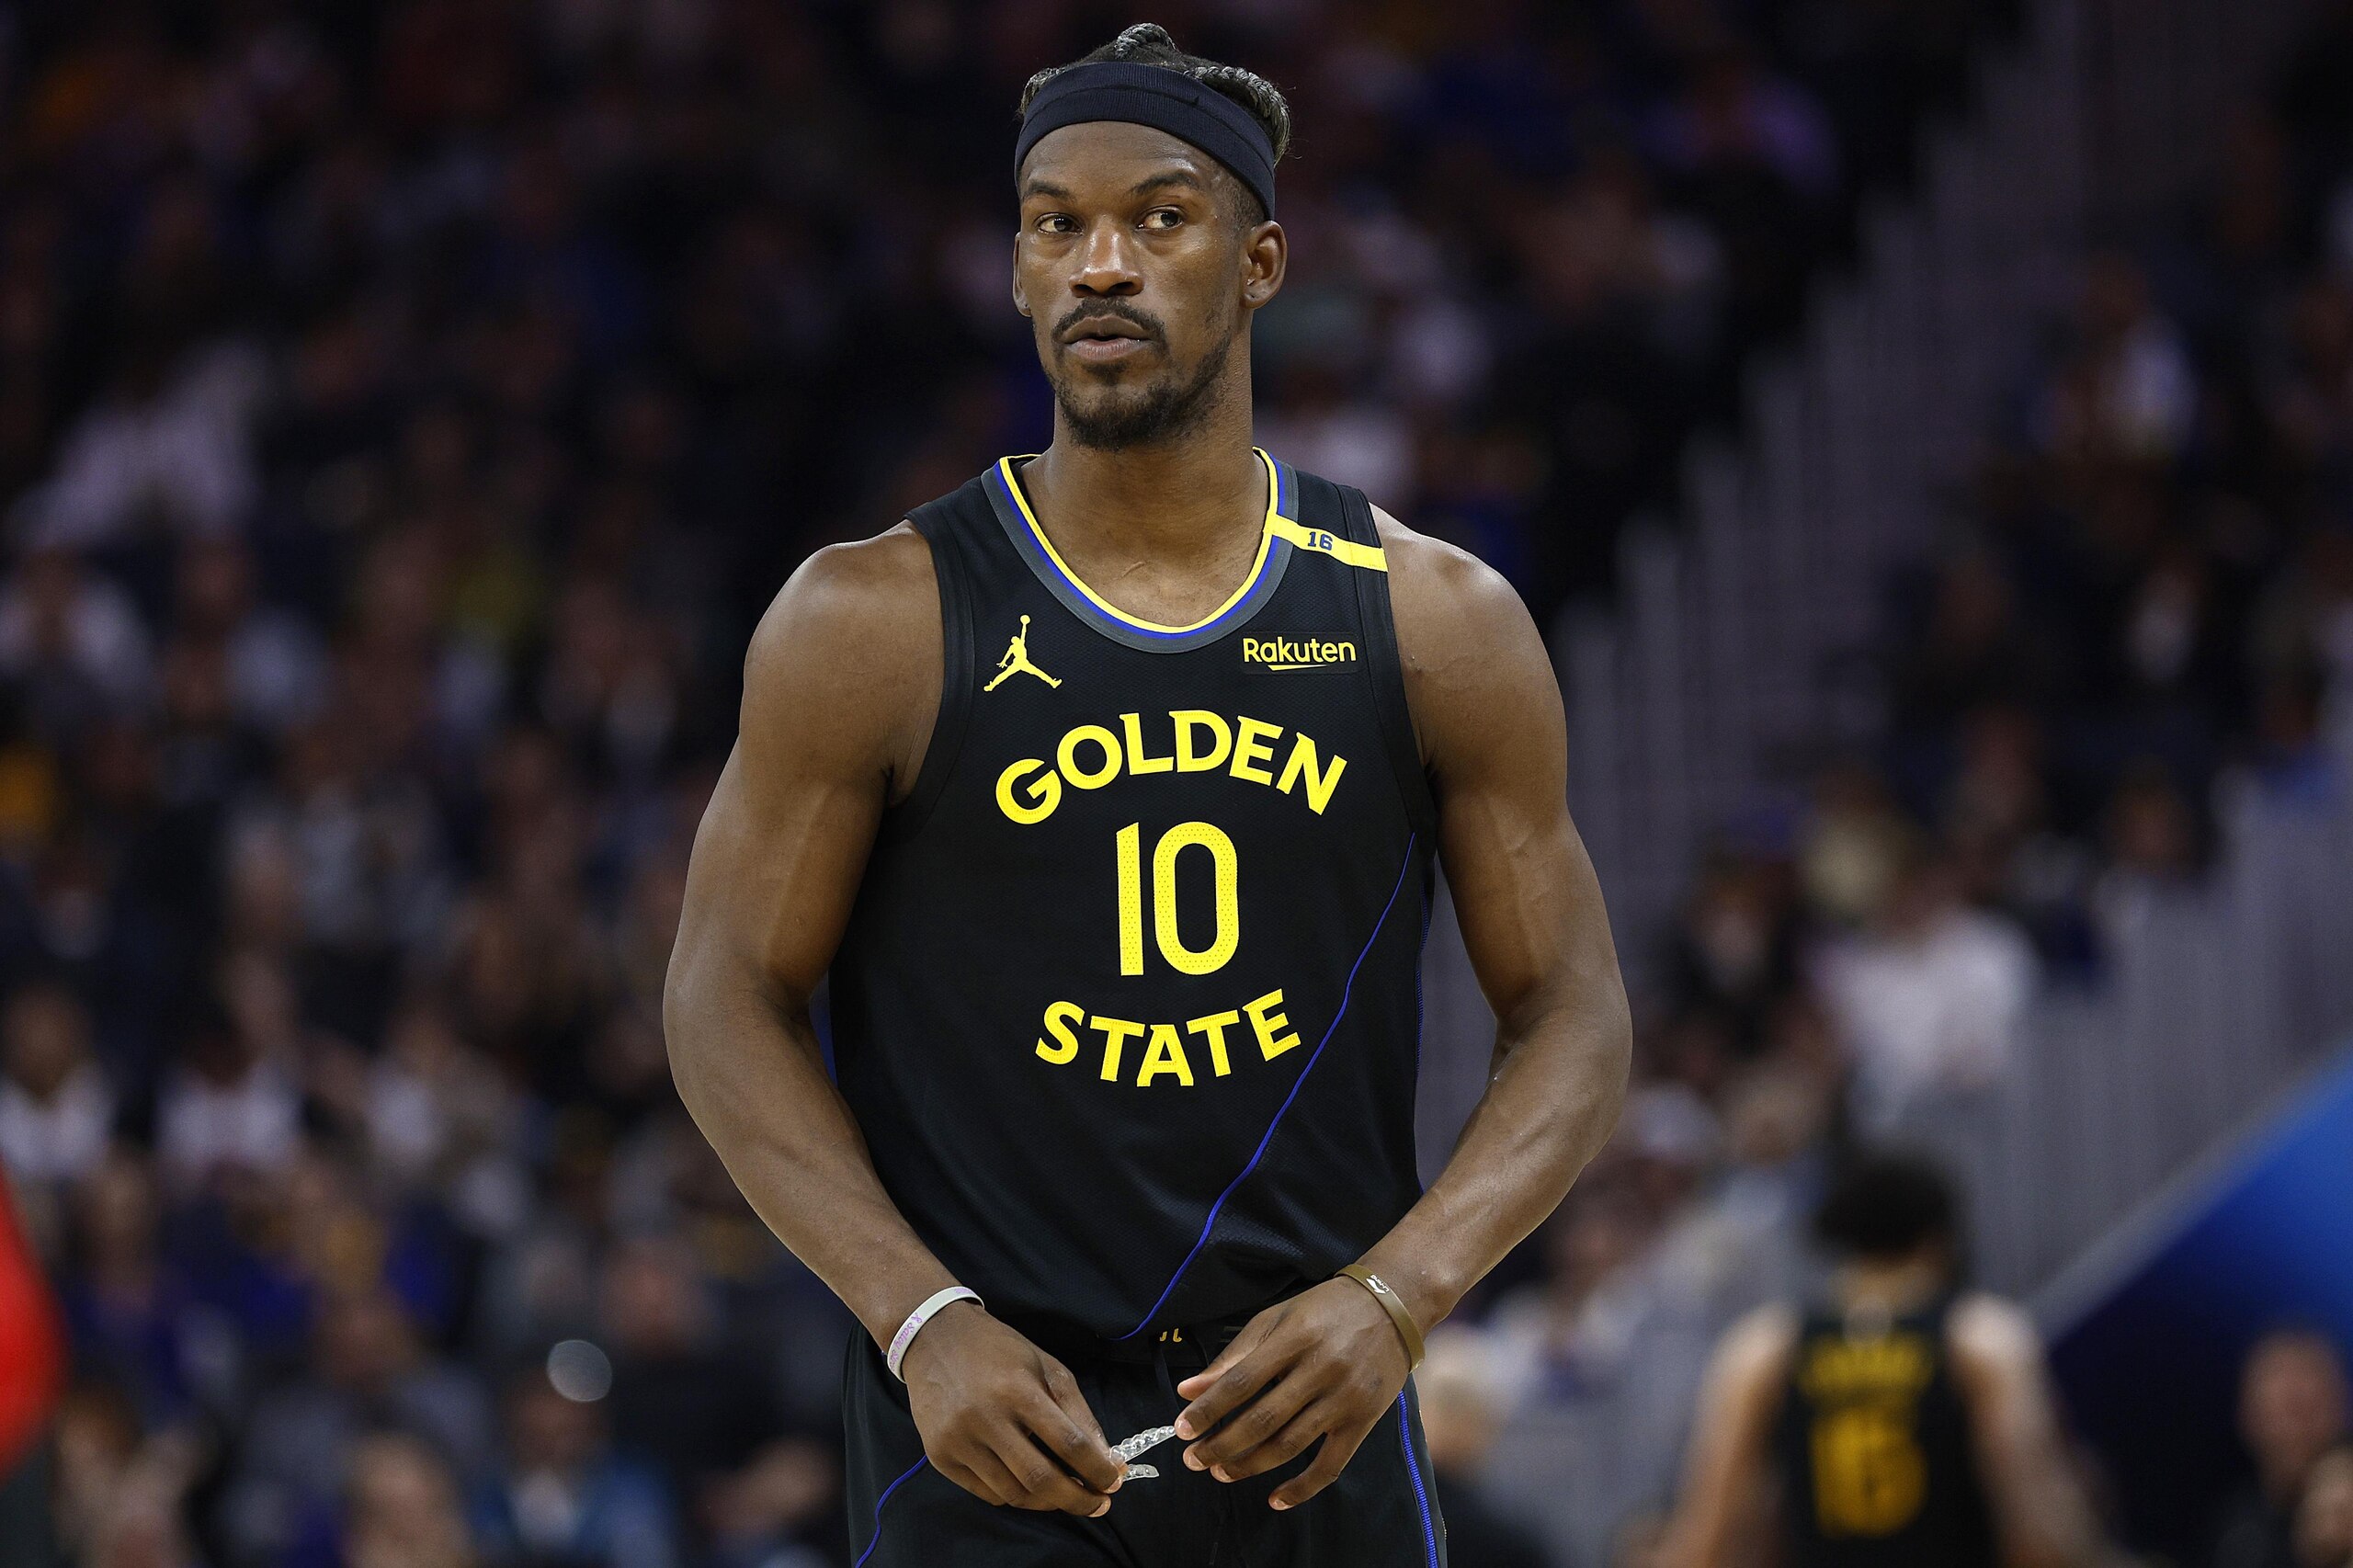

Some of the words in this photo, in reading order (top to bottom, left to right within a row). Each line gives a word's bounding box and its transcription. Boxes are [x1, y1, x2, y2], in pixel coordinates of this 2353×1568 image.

[1307, 531, 1334, 551] 16
[1243, 636, 1357, 663] Rakuten
[995, 710, 1347, 824] GOLDEN
[1116, 821, 1240, 976] 10
[1035, 988, 1302, 1087] STATE
